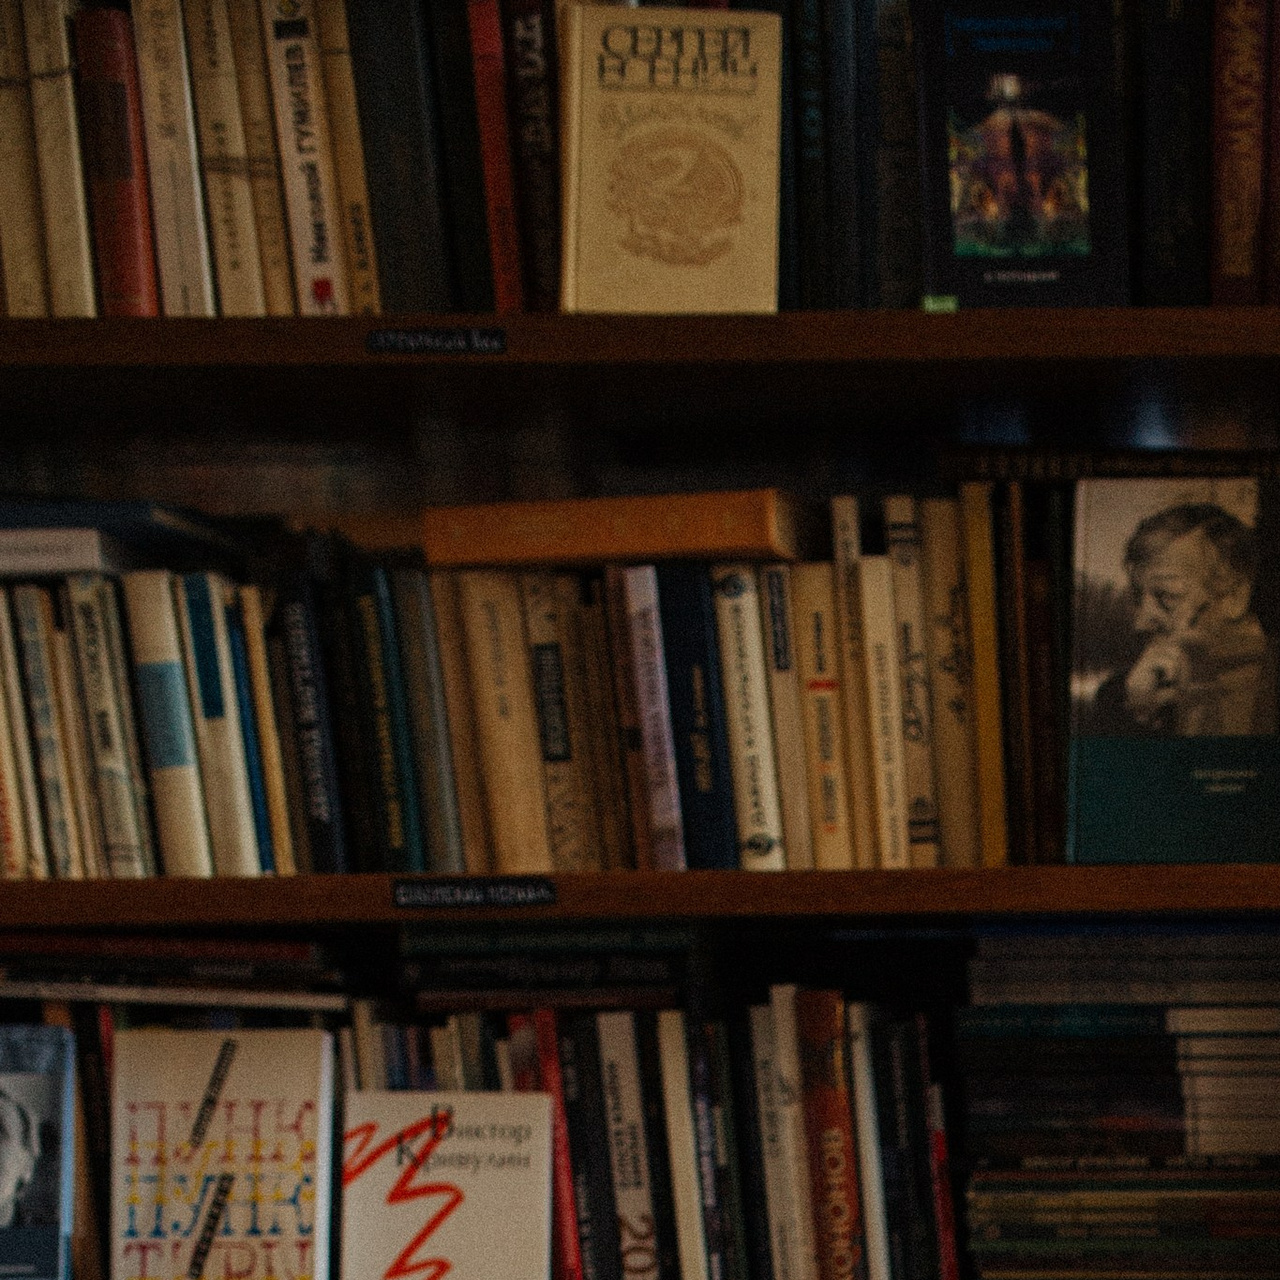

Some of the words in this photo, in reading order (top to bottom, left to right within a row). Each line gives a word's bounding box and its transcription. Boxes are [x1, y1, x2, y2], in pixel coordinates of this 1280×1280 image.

[600, 25, 751, 58] СЕРГЕЙ
[285, 44, 316, 155] ГУМИЛЕВ
[299, 162, 331, 265] Николай
[431, 1103, 533, 1145] Виктор
[397, 1135, 533, 1175] Кривулин
